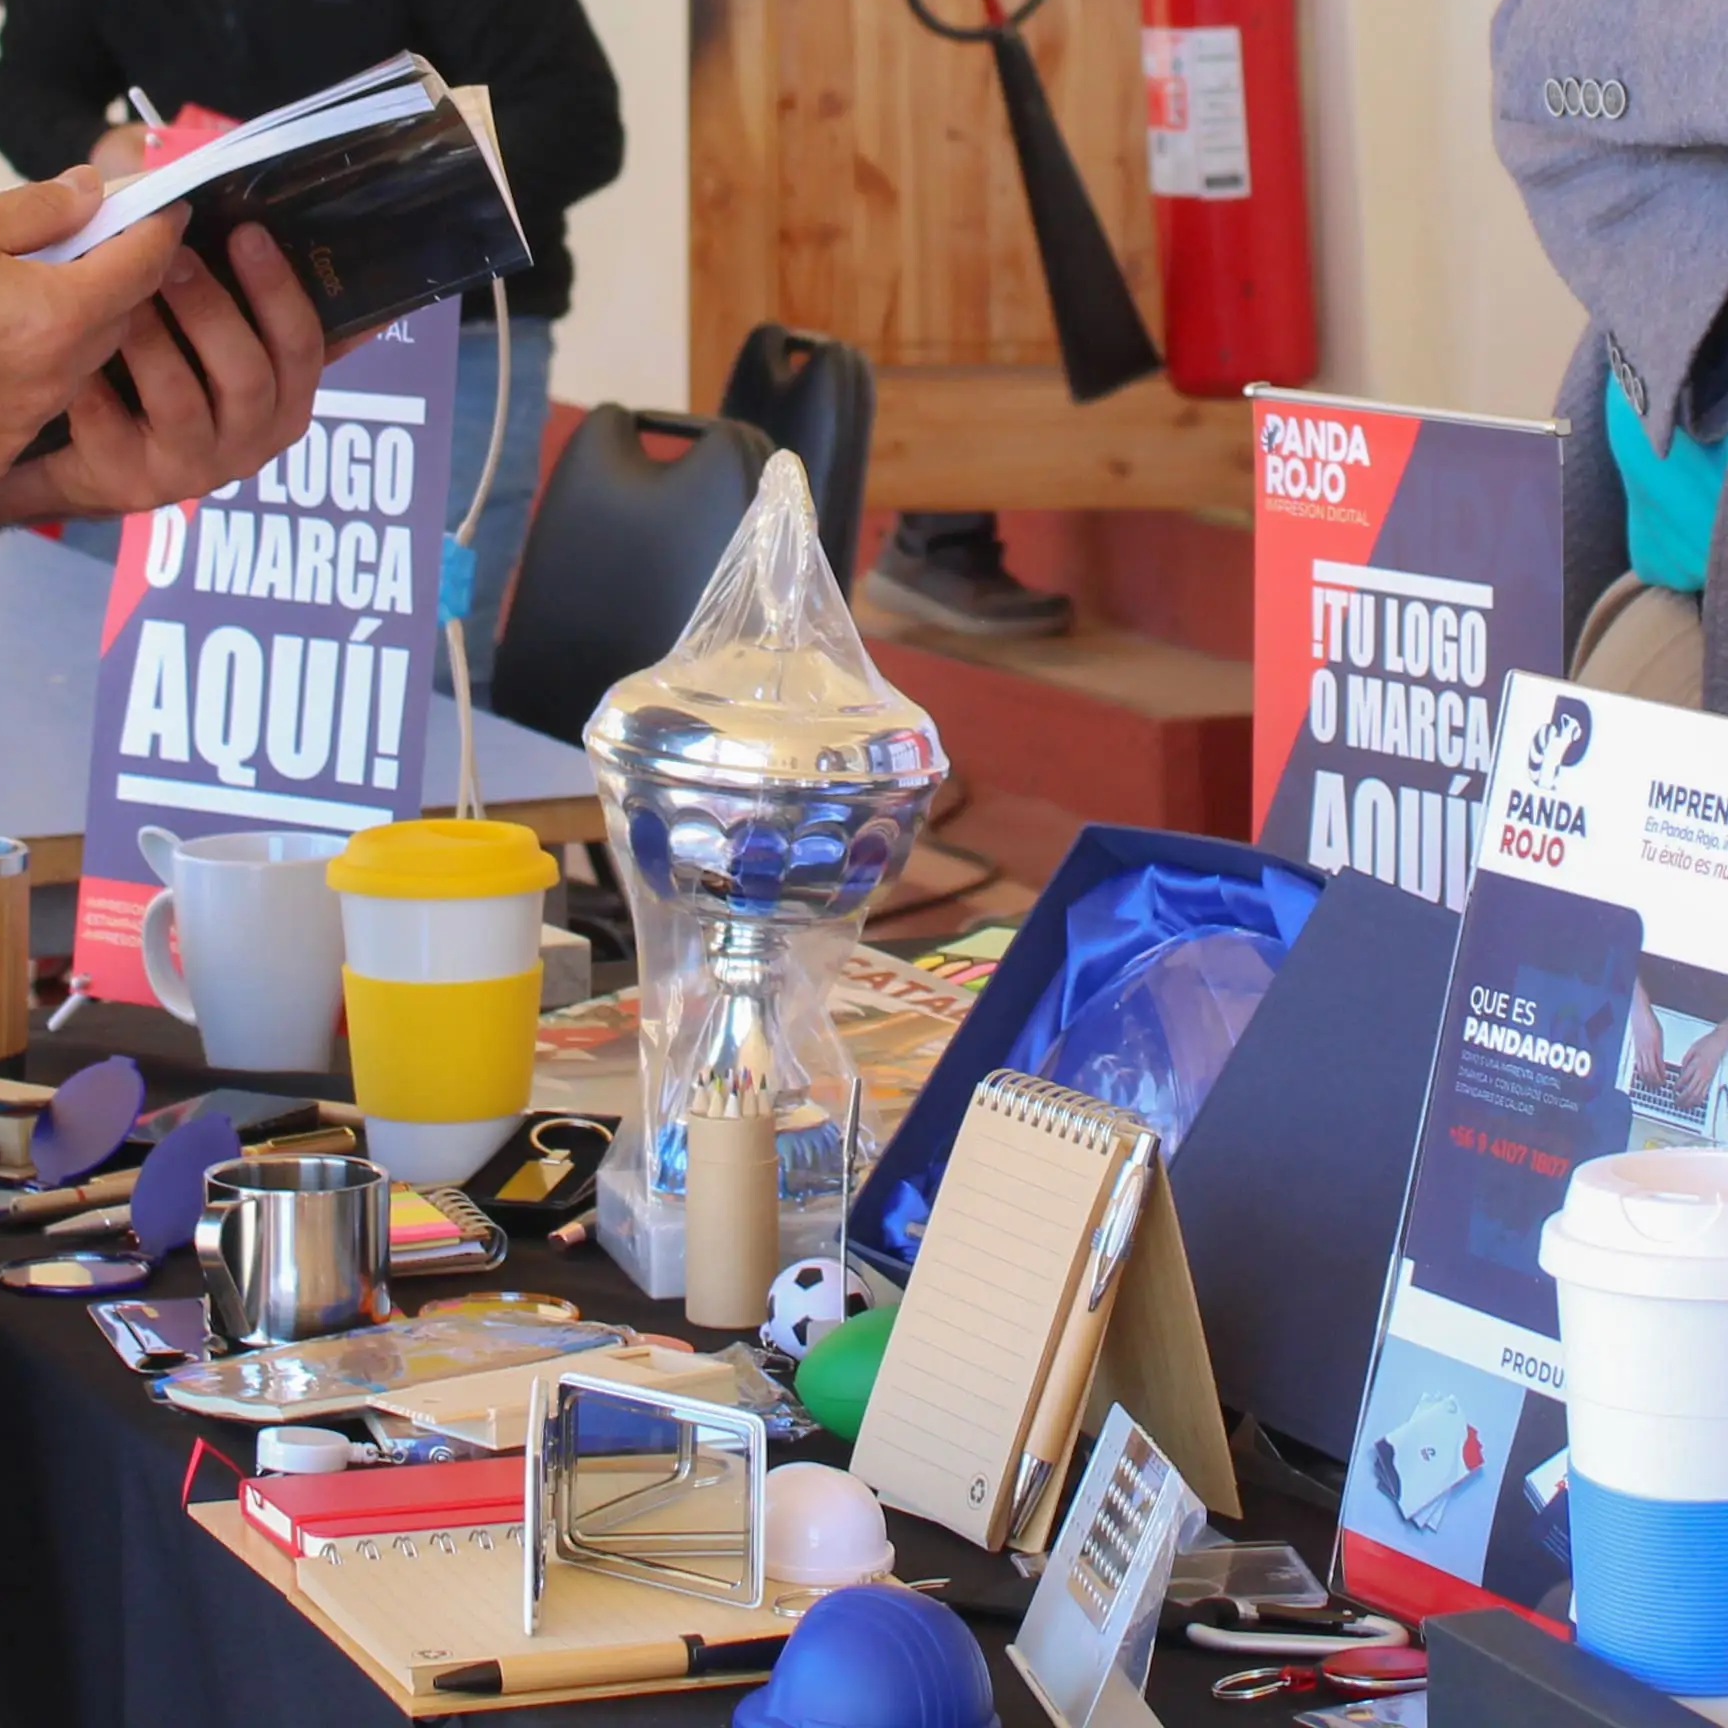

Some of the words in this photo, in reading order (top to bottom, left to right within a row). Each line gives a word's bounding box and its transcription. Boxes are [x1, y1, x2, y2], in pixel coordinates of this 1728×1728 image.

[1263, 413, 1371, 467] PANDA
[1266, 454, 1346, 504] ROJO
[193, 509, 414, 614] MARCA
[1383, 598, 1488, 688] LOGO
[119, 618, 411, 791] AQUÍ!
[1309, 667, 1338, 744] O
[1346, 673, 1492, 773] MARCA
[1507, 789, 1587, 838] PANDA
[1307, 769, 1483, 914] AQUÍ
[1499, 824, 1566, 868] ROJO
[1641, 839, 1658, 860] Tu
[1694, 855, 1711, 872] es
[1470, 985, 1509, 1019] QUE
[1512, 997, 1537, 1026] ES
[1463, 1016, 1591, 1078] PANDAROJO
[1500, 1347, 1566, 1390] PRODU
